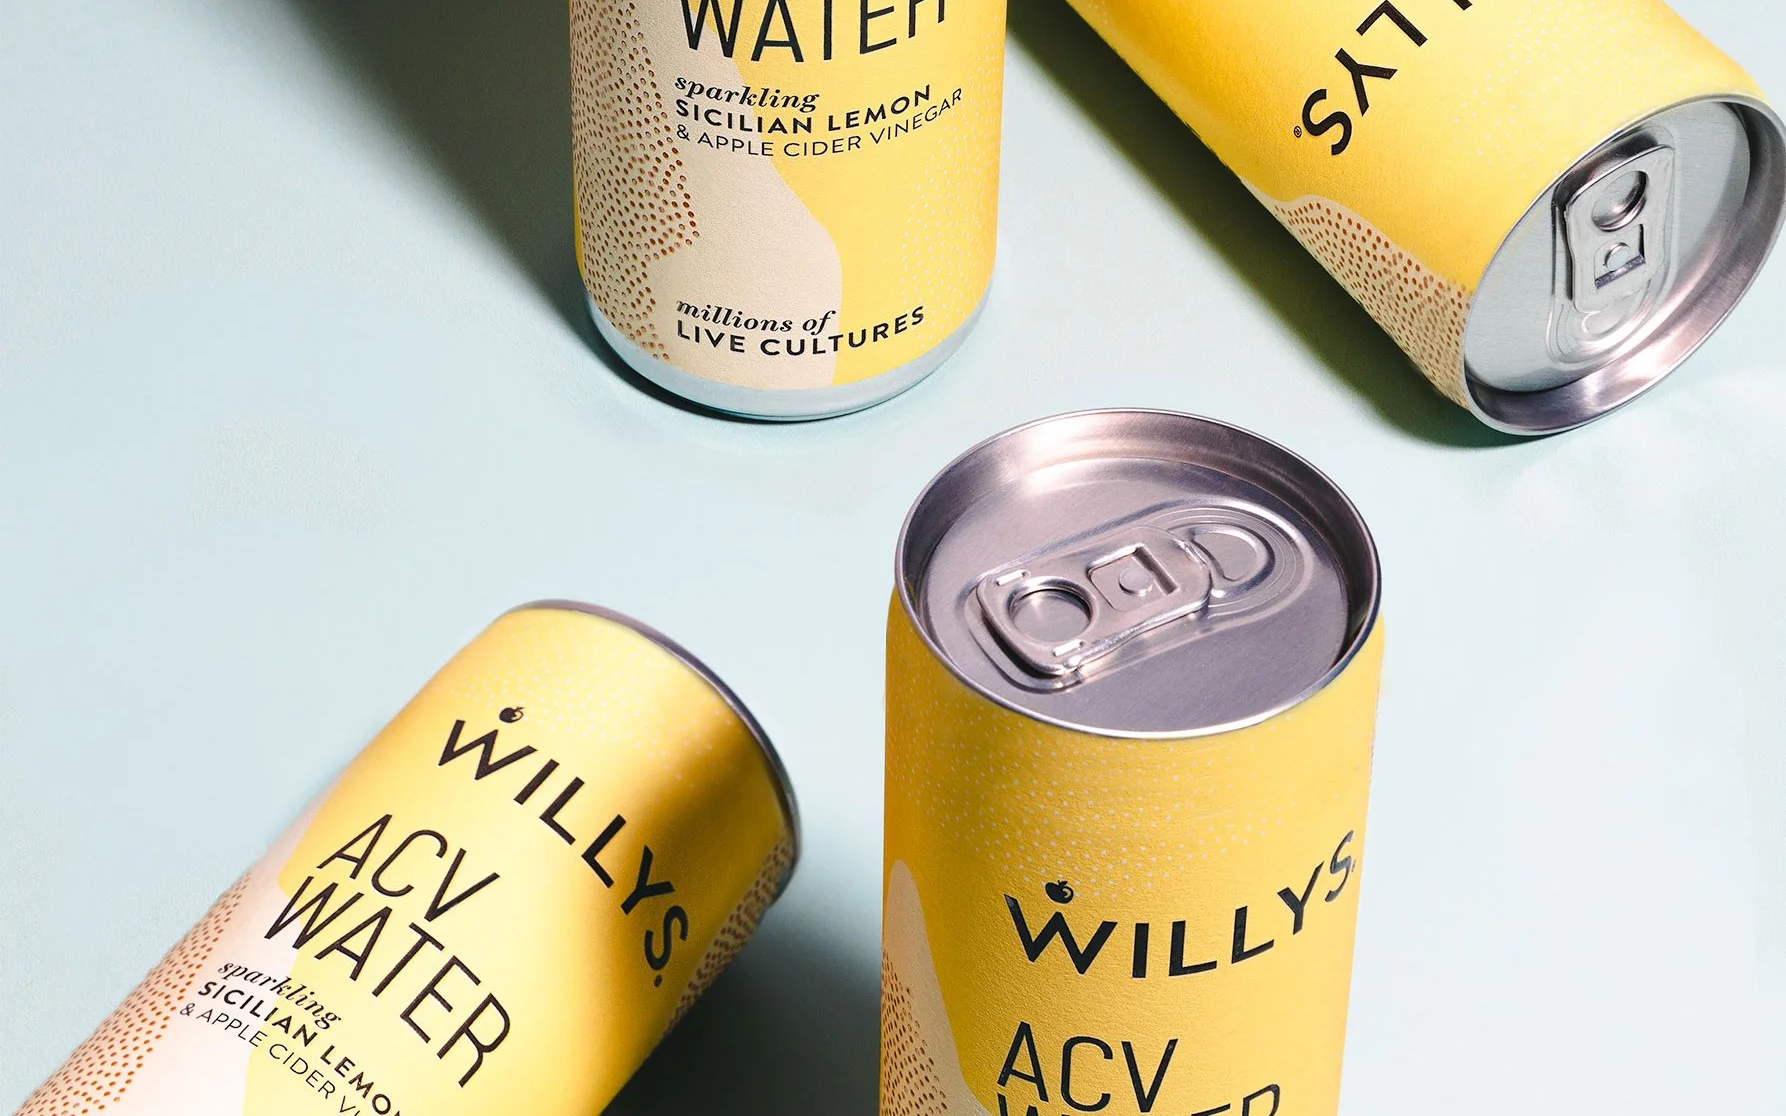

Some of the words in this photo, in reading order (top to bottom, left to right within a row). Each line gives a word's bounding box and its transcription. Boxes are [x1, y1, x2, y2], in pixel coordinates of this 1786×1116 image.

[675, 77, 819, 113] sparkling
[676, 99, 812, 134] SICILIAN
[828, 84, 930, 131] LEMON
[677, 124, 690, 141] &
[697, 132, 774, 157] APPLE
[784, 136, 861, 157] CIDER
[869, 88, 962, 144] VINEGAR
[676, 300, 793, 332] millions
[802, 310, 836, 335] of
[677, 319, 745, 353] LIVE
[760, 306, 924, 356] CULTURES
[317, 814, 500, 922] ACV
[218, 962, 341, 1030] sparkling
[264, 876, 511, 1088] WATER
[180, 1002, 195, 1016] &
[196, 1008, 268, 1048] APPLE
[269, 1043, 336, 1099] CIDER
[198, 981, 318, 1047] SICILIAN
[320, 1045, 402, 1116] LEMO
[997, 1021, 1179, 1113] ACV
